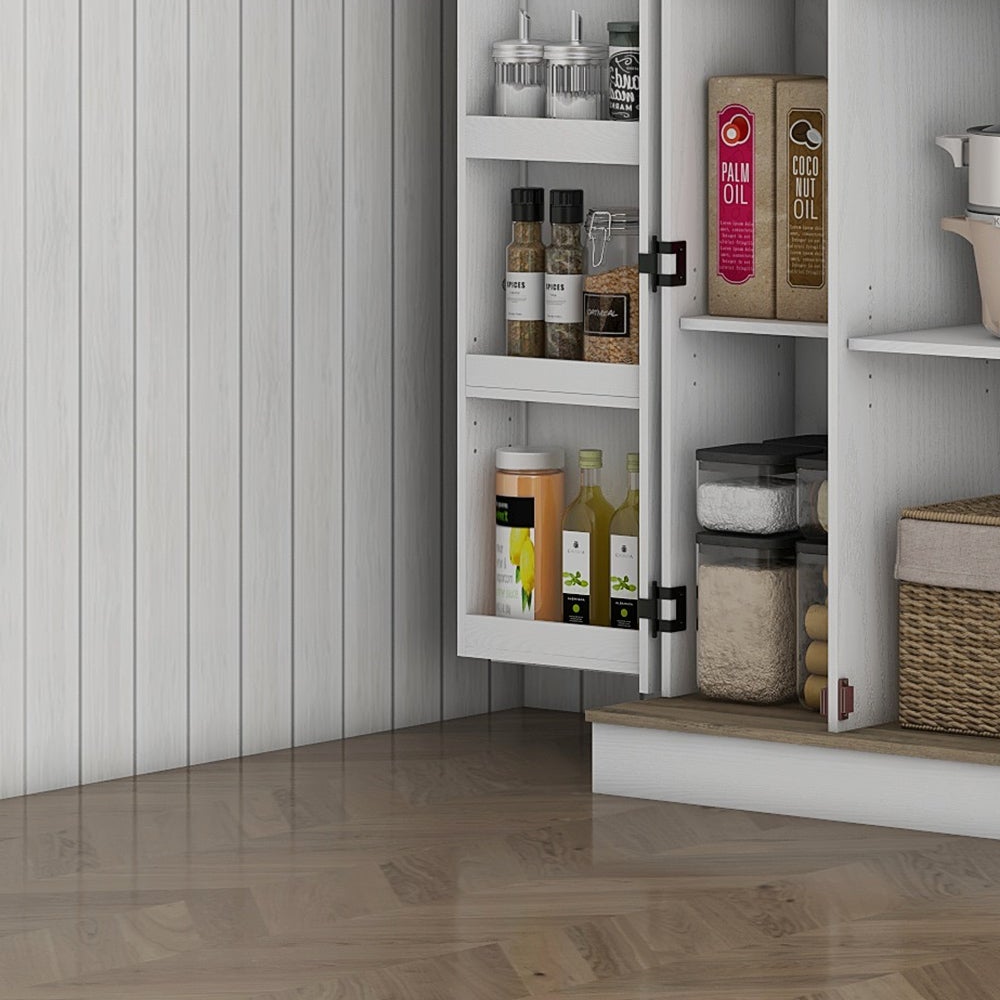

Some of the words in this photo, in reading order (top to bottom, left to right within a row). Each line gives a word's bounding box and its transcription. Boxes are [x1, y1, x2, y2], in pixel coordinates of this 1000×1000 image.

[721, 161, 750, 183] PALM
[792, 154, 819, 177] COCO
[723, 183, 749, 205] OIL
[795, 177, 816, 198] NUT
[793, 198, 818, 220] OIL
